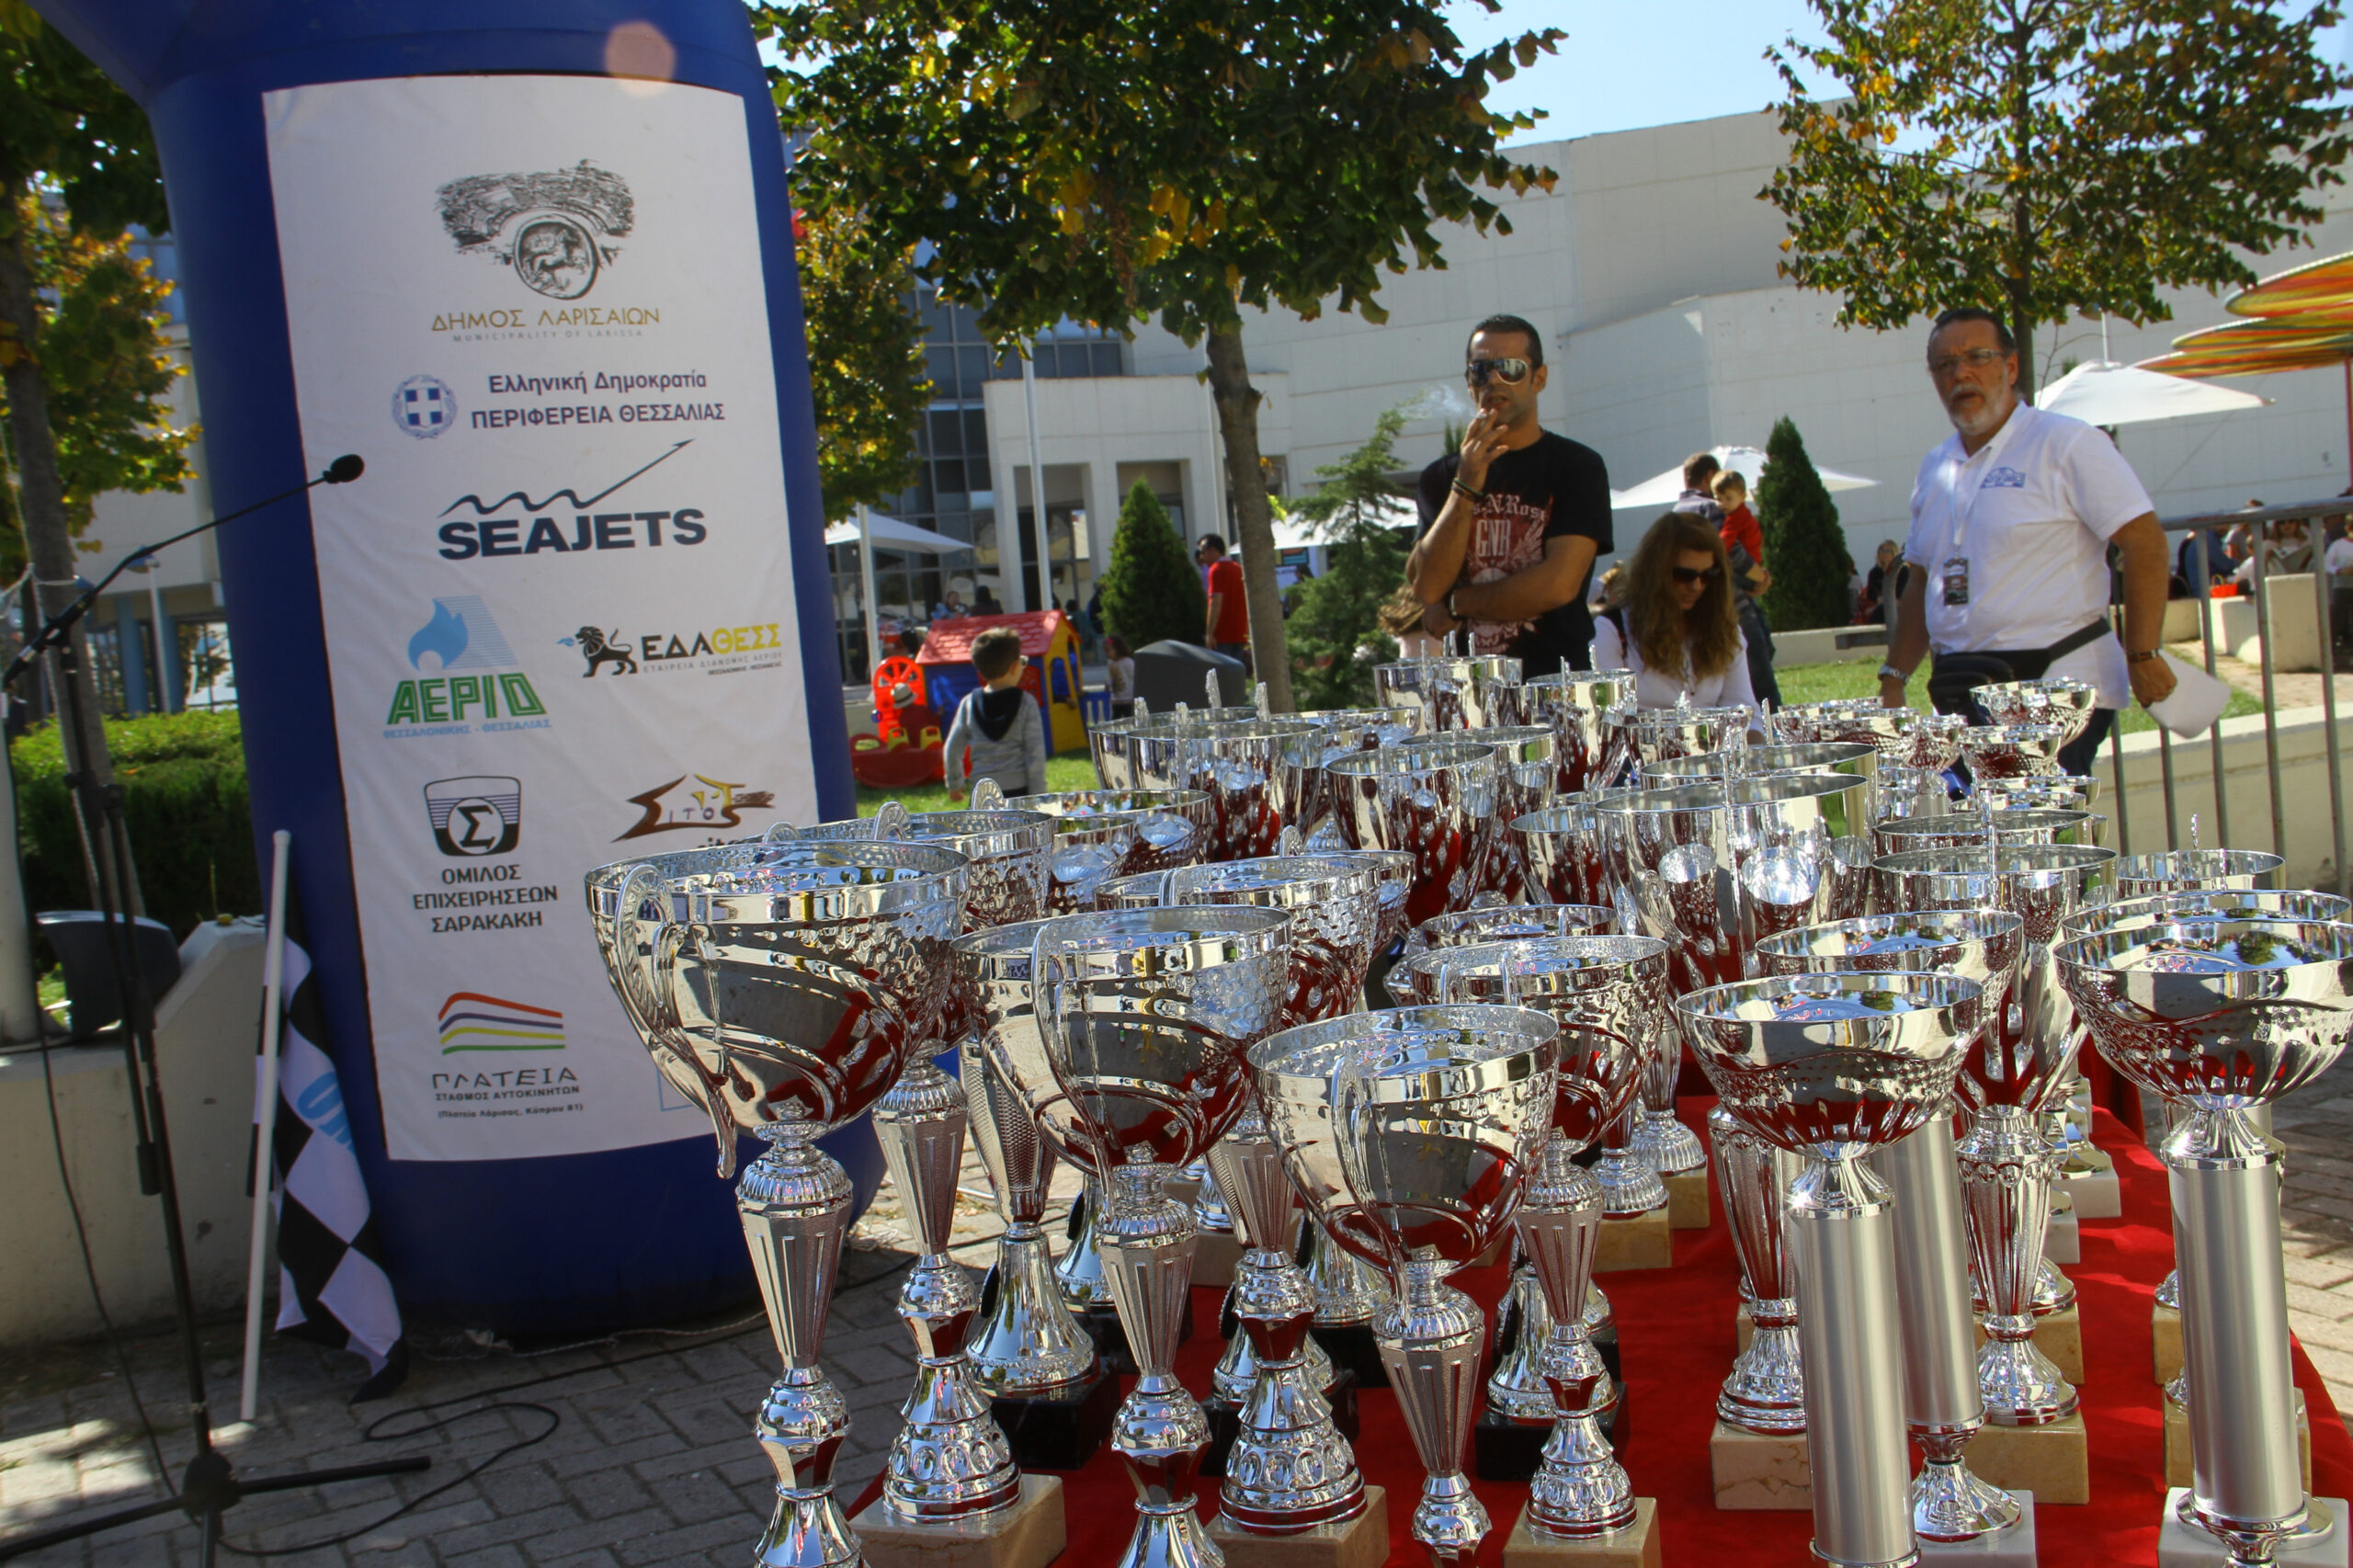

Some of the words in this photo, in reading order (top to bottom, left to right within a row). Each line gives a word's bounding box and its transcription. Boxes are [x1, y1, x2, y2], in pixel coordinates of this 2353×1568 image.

[431, 310, 527, 332] ΔΗΜΟΣ
[538, 307, 661, 327] ΛΑΡΙΣΑΙΩΝ
[453, 330, 558, 343] MUNICIPALITY
[564, 330, 582, 338] OF
[587, 328, 643, 338] LARISSA
[488, 371, 587, 395] Ελληνική
[594, 369, 707, 393] Δημοκρατία
[471, 405, 613, 429] ΠΕΡΙΦΕΡΕΙΑ
[619, 403, 726, 423] ΘΕΣΣΑΛΙΑΣ
[437, 508, 708, 561] SEAJETS
[441, 864, 522, 885] ΟΜΙΛΟΣ
[413, 885, 559, 910] ΕΠΙΧΕΙΡΗΣΕΩΝ
[431, 910, 543, 934] ΣΑΡΑΚΑΚΗ
[431, 1066, 579, 1090] ΠΛΑΤΕΙΑ
